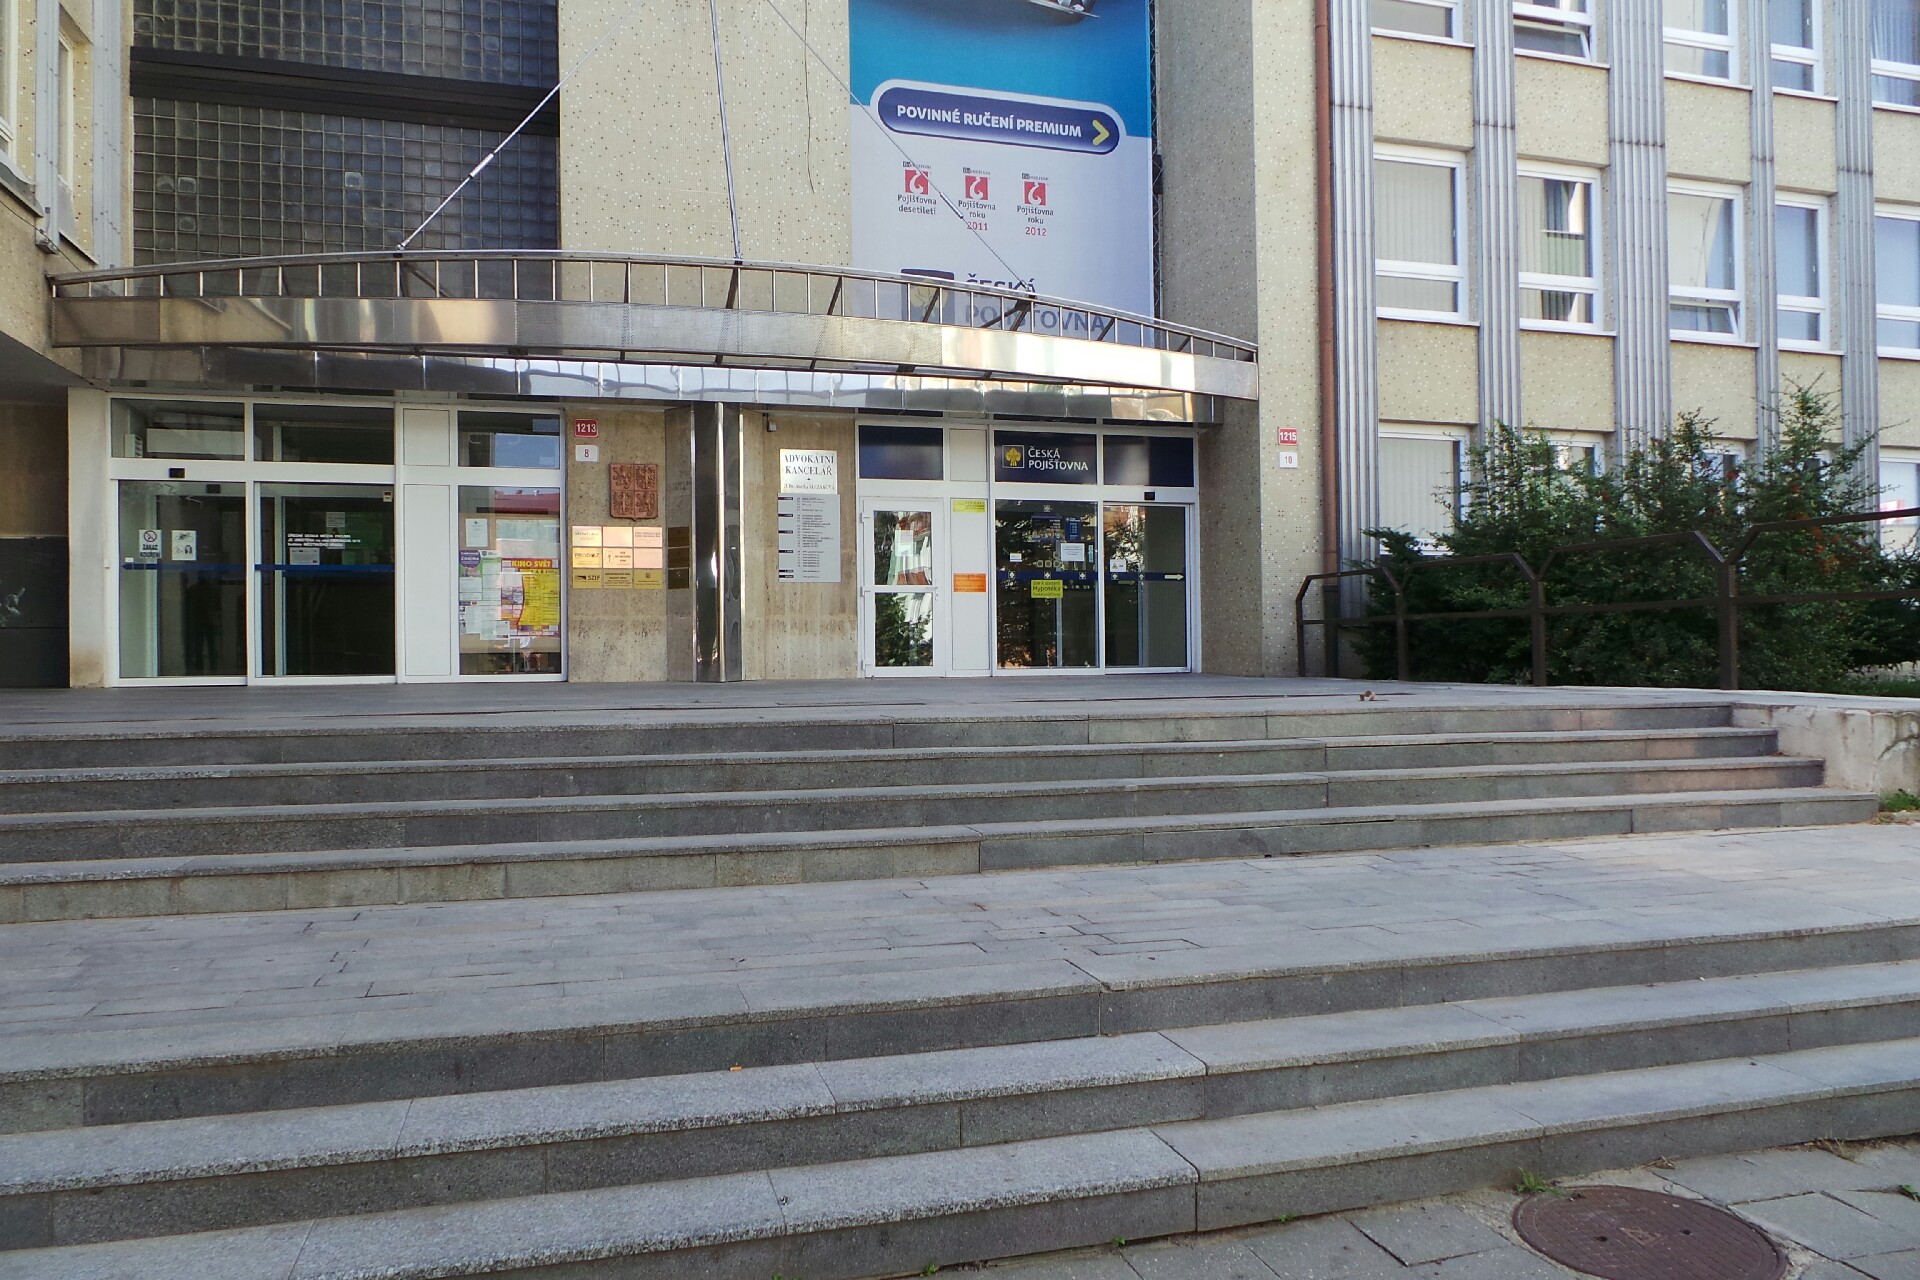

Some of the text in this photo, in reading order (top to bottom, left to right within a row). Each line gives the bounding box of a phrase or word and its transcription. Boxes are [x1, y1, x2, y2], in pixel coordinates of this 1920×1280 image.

[897, 105, 1082, 137] POVINNÉ RUČENÍ PREMIUM
[897, 194, 937, 205] Pojišťovna
[898, 205, 936, 215] desetiletí
[958, 200, 996, 210] Pojišťovna
[969, 211, 986, 219] roku
[1017, 205, 1054, 216] Pojišťovna
[1027, 216, 1044, 224] roku
[967, 222, 988, 231] 2011
[1025, 227, 1047, 236] 2012
[576, 423, 596, 433] 1213
[1279, 431, 1297, 441] 1215
[1028, 445, 1061, 459] ČESKÁ
[784, 452, 834, 464] ADVOKÁTNÍ
[1284, 455, 1293, 464] 10
[1028, 458, 1089, 471] POJIŠŤOVNA
[785, 465, 832, 476] KANCELÁŘ
